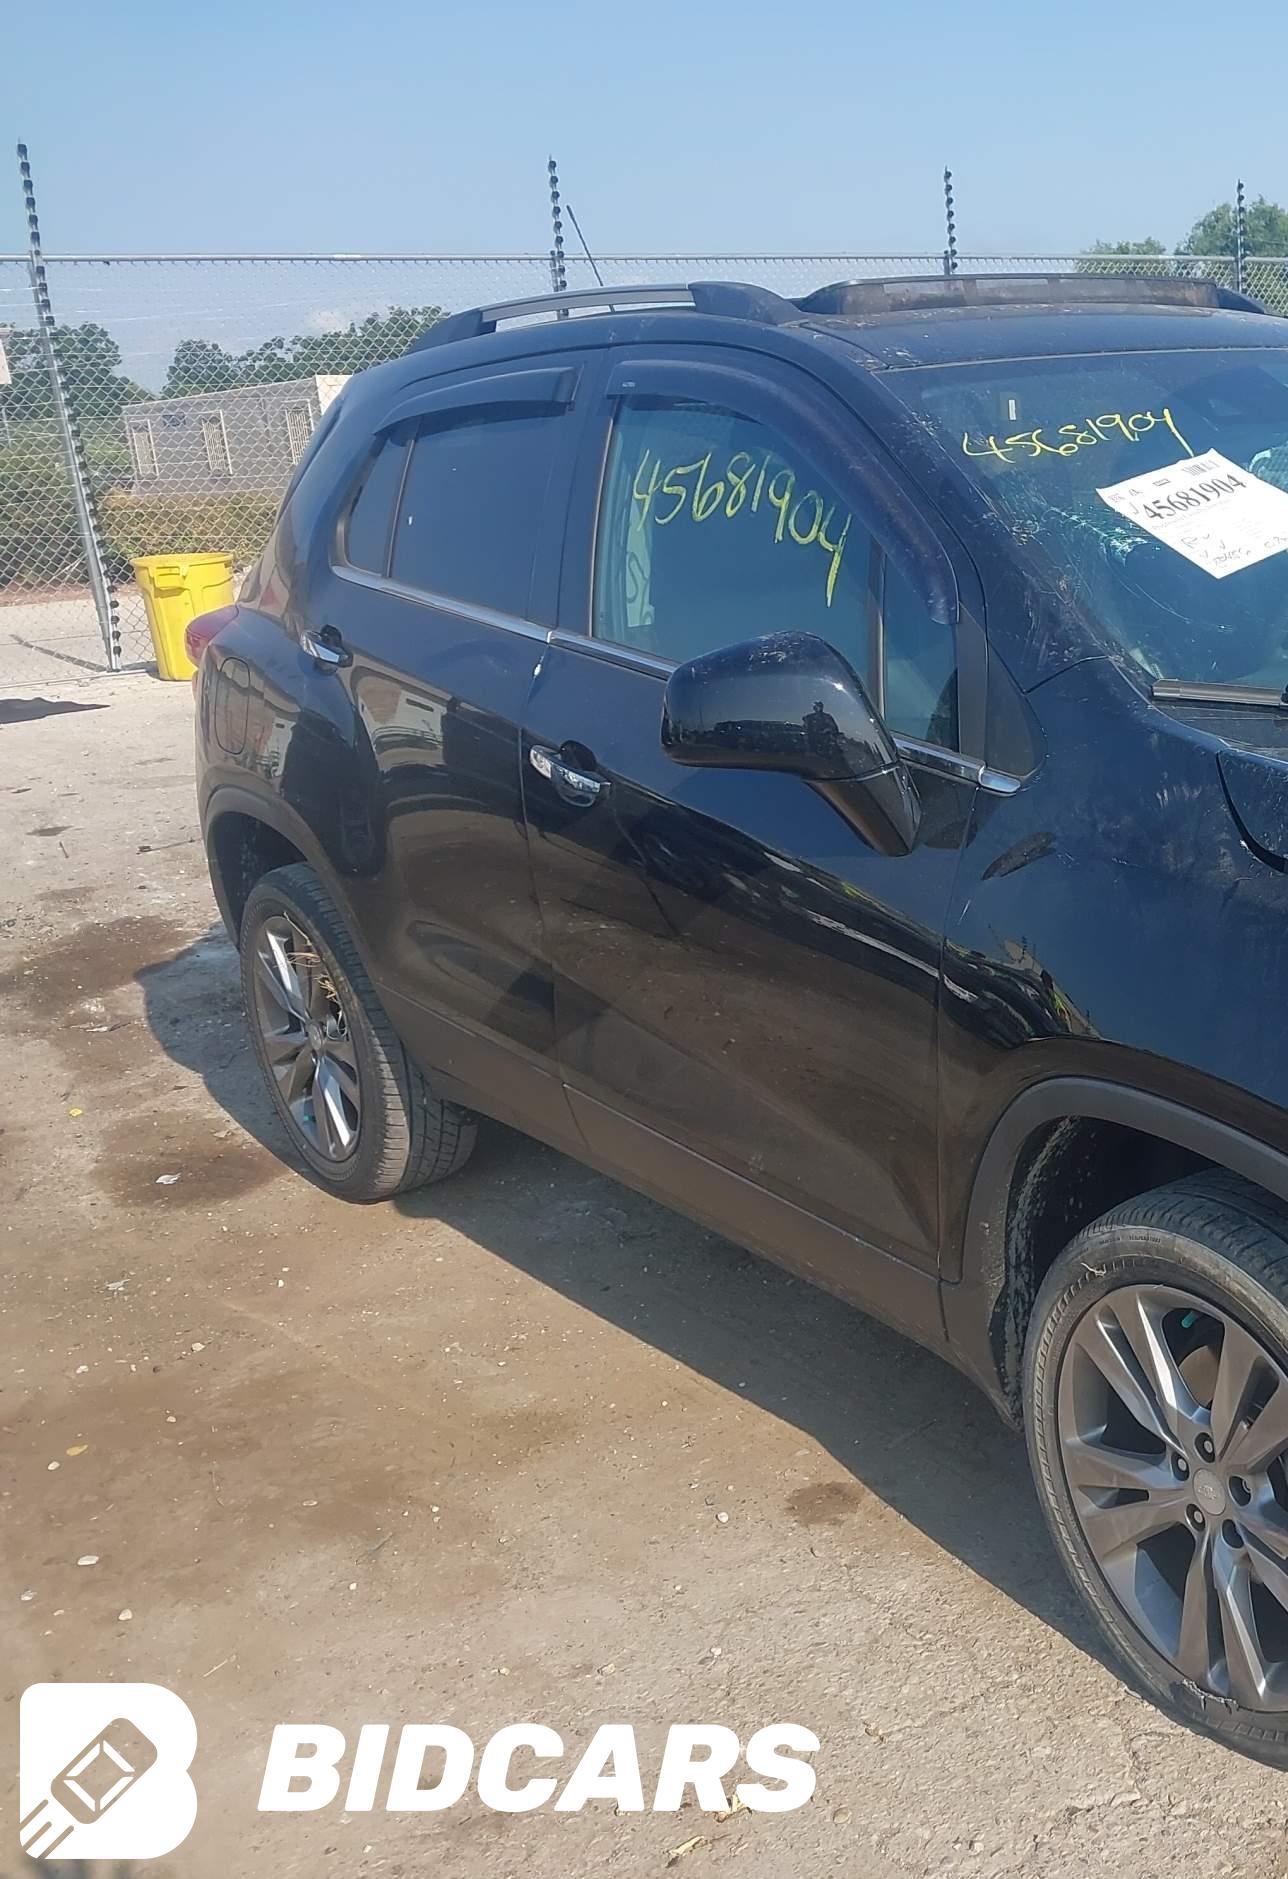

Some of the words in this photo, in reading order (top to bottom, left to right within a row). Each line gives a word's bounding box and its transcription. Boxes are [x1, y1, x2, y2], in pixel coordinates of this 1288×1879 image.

[962, 407, 1195, 464] 45681904
[1142, 472, 1248, 521] 45681904
[632, 448, 853, 609] 45681904
